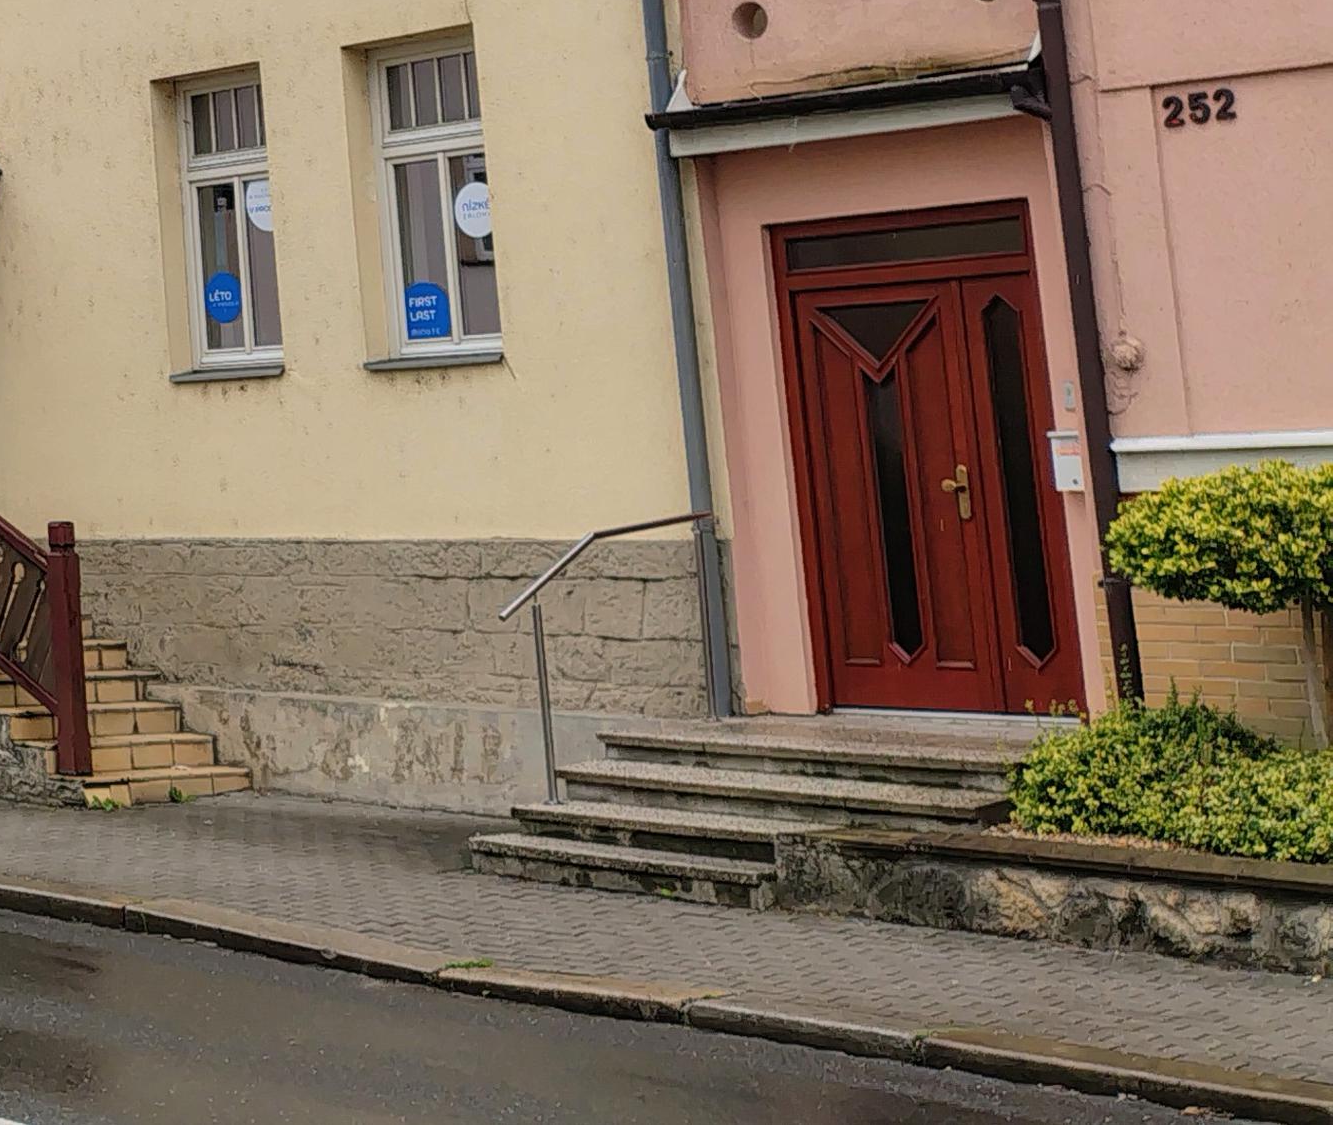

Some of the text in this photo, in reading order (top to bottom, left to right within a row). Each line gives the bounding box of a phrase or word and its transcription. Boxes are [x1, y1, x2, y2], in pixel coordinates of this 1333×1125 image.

[1162, 88, 1238, 128] 252
[208, 289, 232, 302] LÉTO
[408, 295, 437, 308] FIRST
[410, 310, 436, 322] LAST
